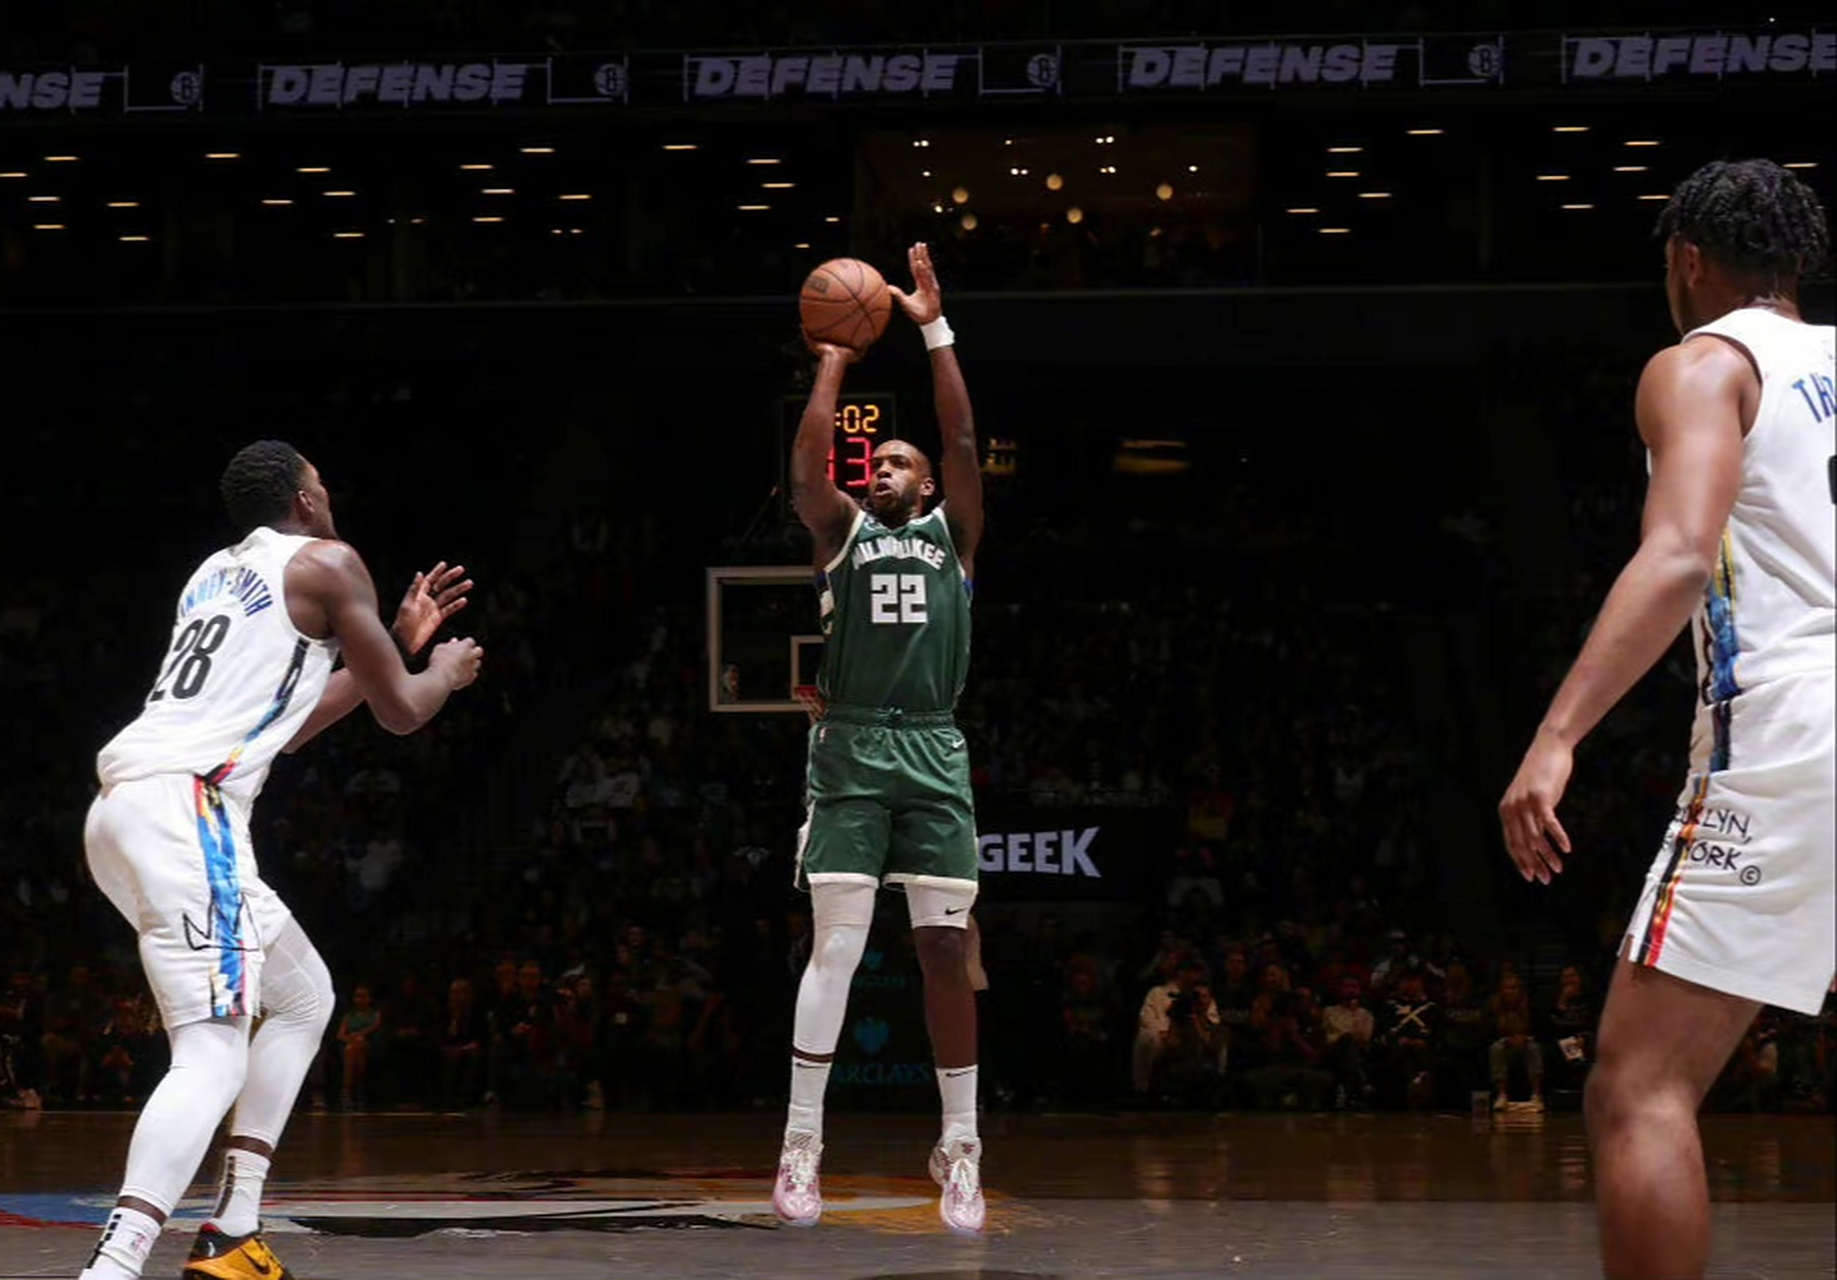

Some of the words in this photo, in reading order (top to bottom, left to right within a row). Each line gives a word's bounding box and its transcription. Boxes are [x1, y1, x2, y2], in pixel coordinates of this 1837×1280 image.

[694, 54, 961, 96] DEFENSE
[1128, 44, 1399, 87] DEFENSE
[1571, 33, 1836, 78] DEFENSE
[268, 64, 527, 104] DEFENSE
[871, 573, 928, 624] 22
[148, 614, 231, 702] 28
[978, 826, 1102, 878] GEEK
[1687, 841, 1742, 871] ORK
